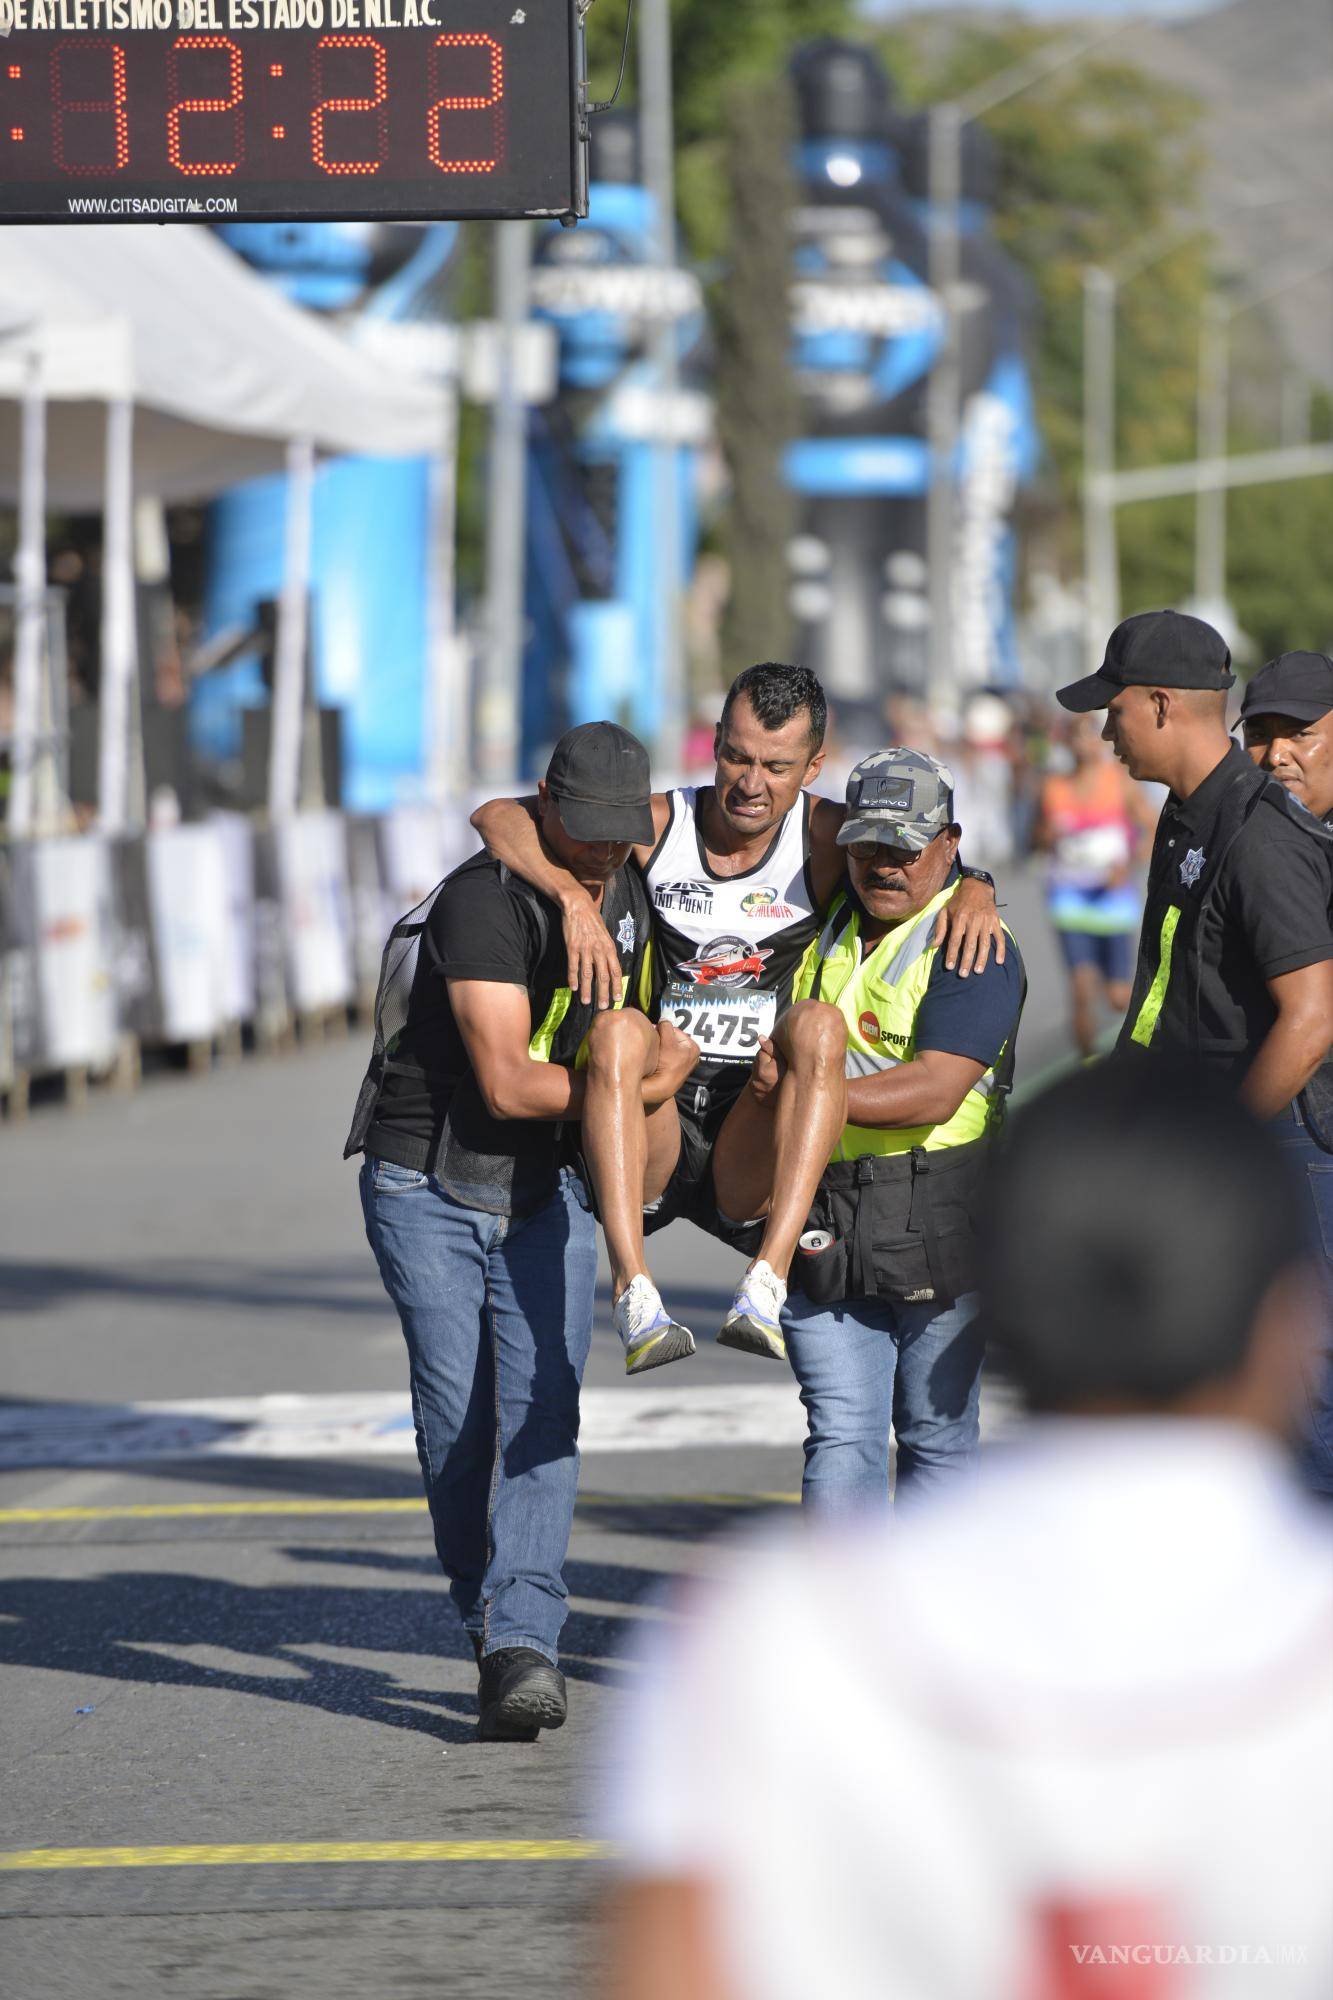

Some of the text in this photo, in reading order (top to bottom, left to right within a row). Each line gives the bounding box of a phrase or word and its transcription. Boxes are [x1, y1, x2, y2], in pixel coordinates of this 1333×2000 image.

[32, 0, 172, 30] ATLETISMO
[178, 0, 223, 30] DEL
[229, 0, 324, 29] ESTADO
[331, 0, 360, 28] DE
[679, 893, 713, 916] PUENTE
[674, 1008, 760, 1048] 2475
[881, 1030, 913, 1047] SPORT
